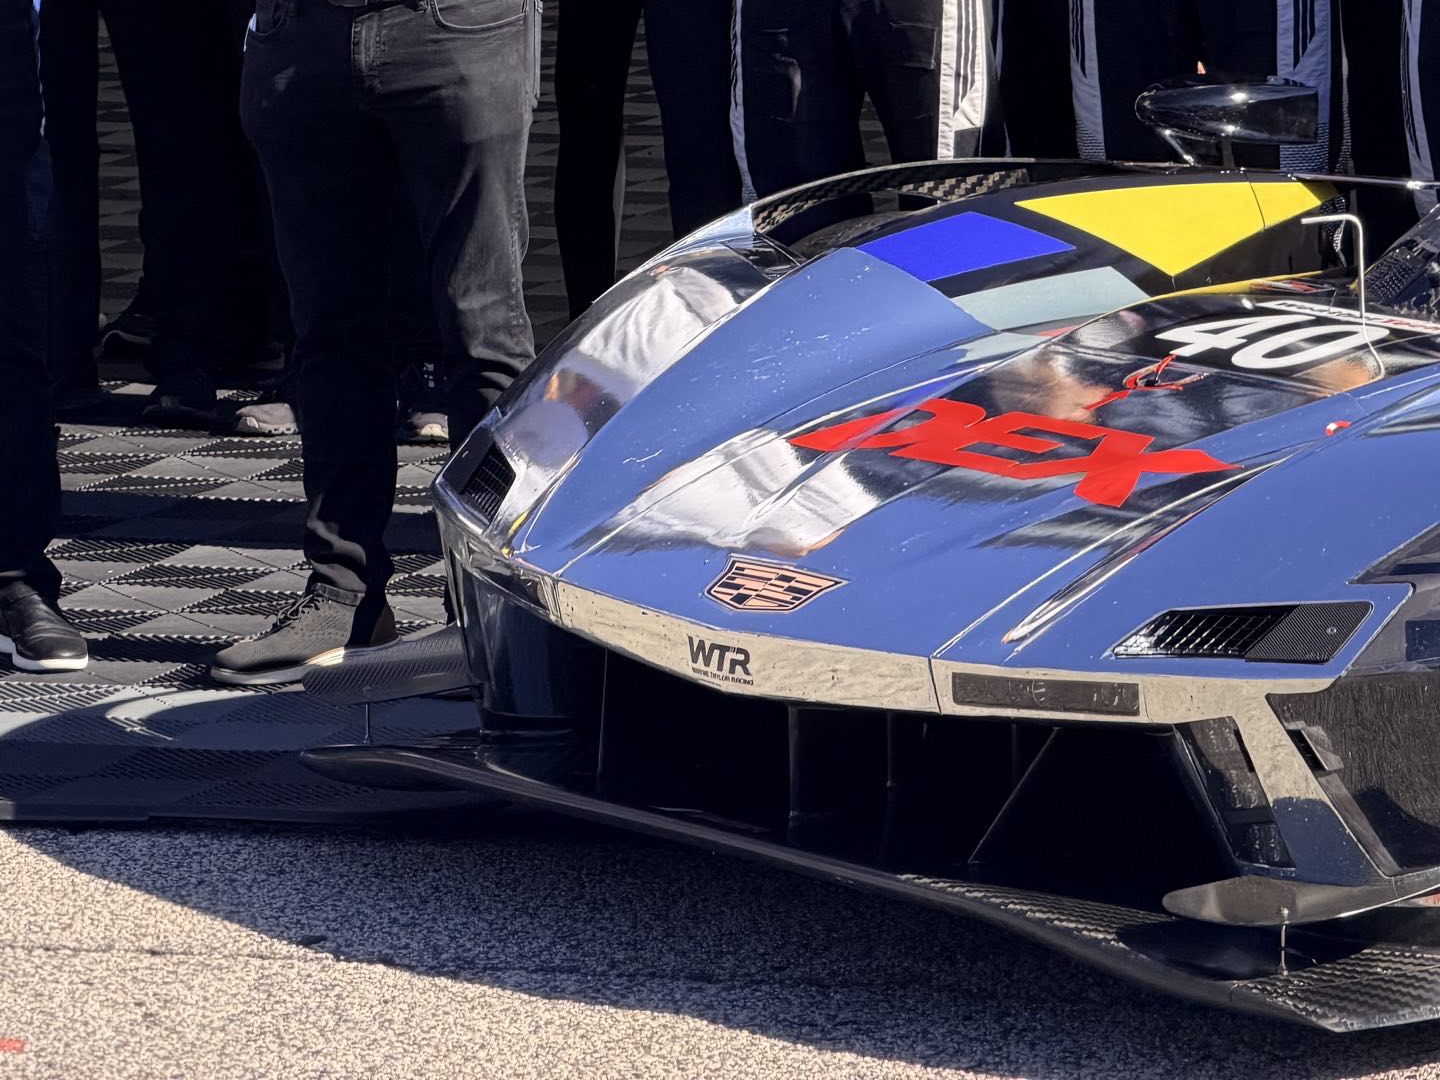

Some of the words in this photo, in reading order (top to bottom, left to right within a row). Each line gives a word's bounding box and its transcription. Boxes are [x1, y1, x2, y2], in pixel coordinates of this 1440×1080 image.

[1154, 314, 1391, 369] 40
[789, 398, 1241, 508] DEX
[687, 635, 752, 676] WTR
